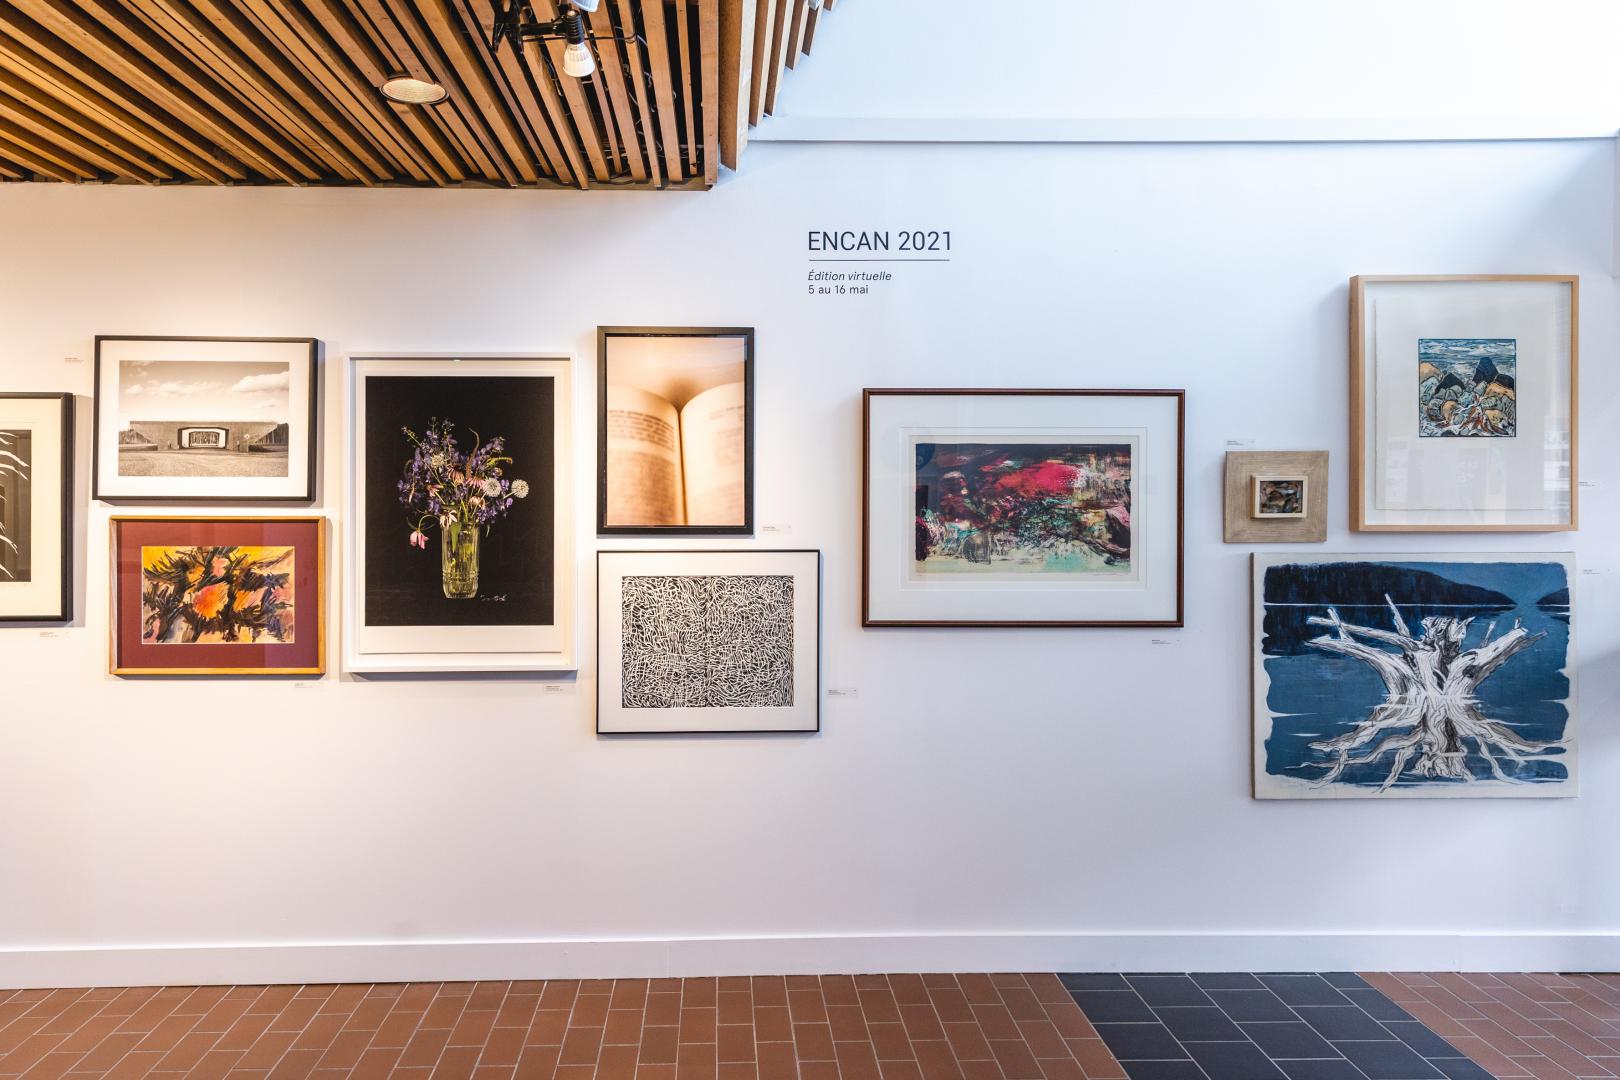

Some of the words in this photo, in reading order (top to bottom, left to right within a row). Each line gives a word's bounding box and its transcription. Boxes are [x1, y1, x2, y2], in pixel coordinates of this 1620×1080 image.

[808, 231, 889, 251] ENCAN
[898, 231, 951, 251] 2021
[807, 269, 845, 281] Édition
[848, 271, 892, 281] virtuelle
[808, 284, 815, 295] 5
[818, 286, 831, 295] au
[834, 284, 846, 295] 16
[849, 284, 869, 295] mai
